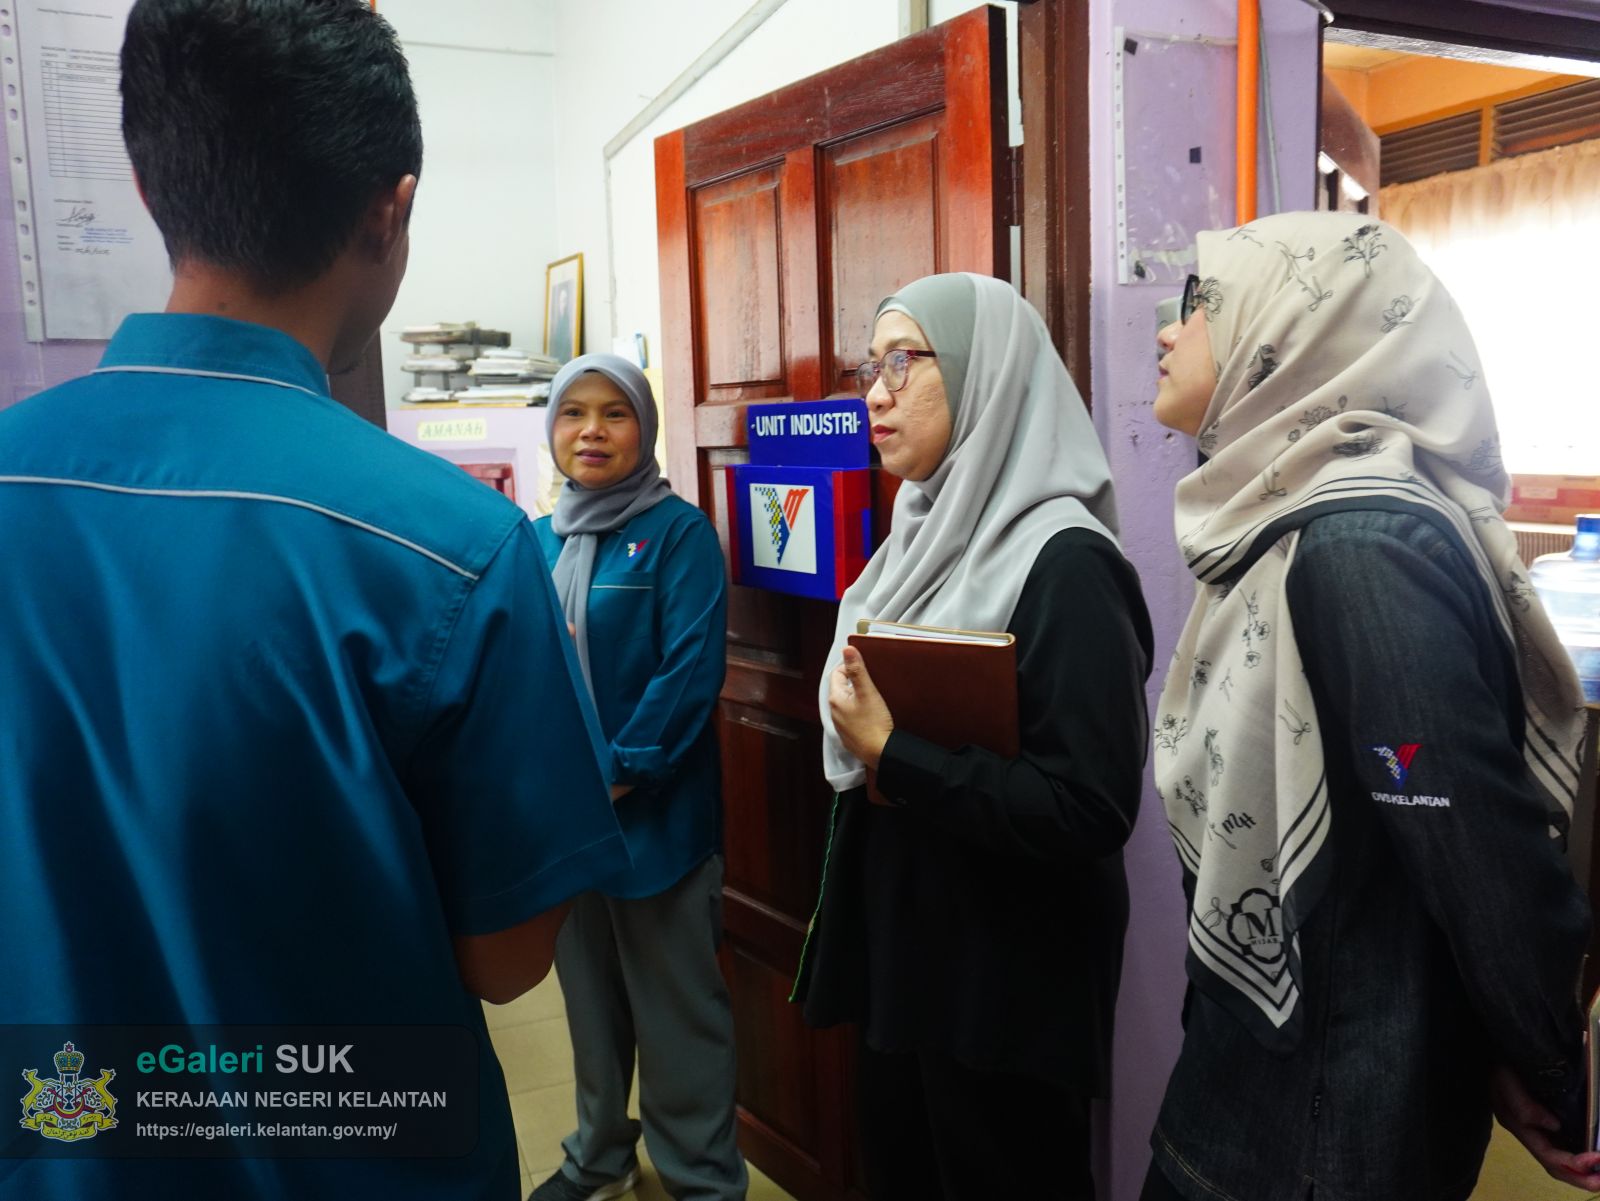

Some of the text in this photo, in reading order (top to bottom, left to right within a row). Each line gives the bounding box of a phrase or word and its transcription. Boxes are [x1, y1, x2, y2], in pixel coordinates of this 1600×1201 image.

[421, 423, 484, 438] AMANAH
[755, 411, 858, 437] UNIT INDUSTRI
[1391, 794, 1451, 808] KELANTAN
